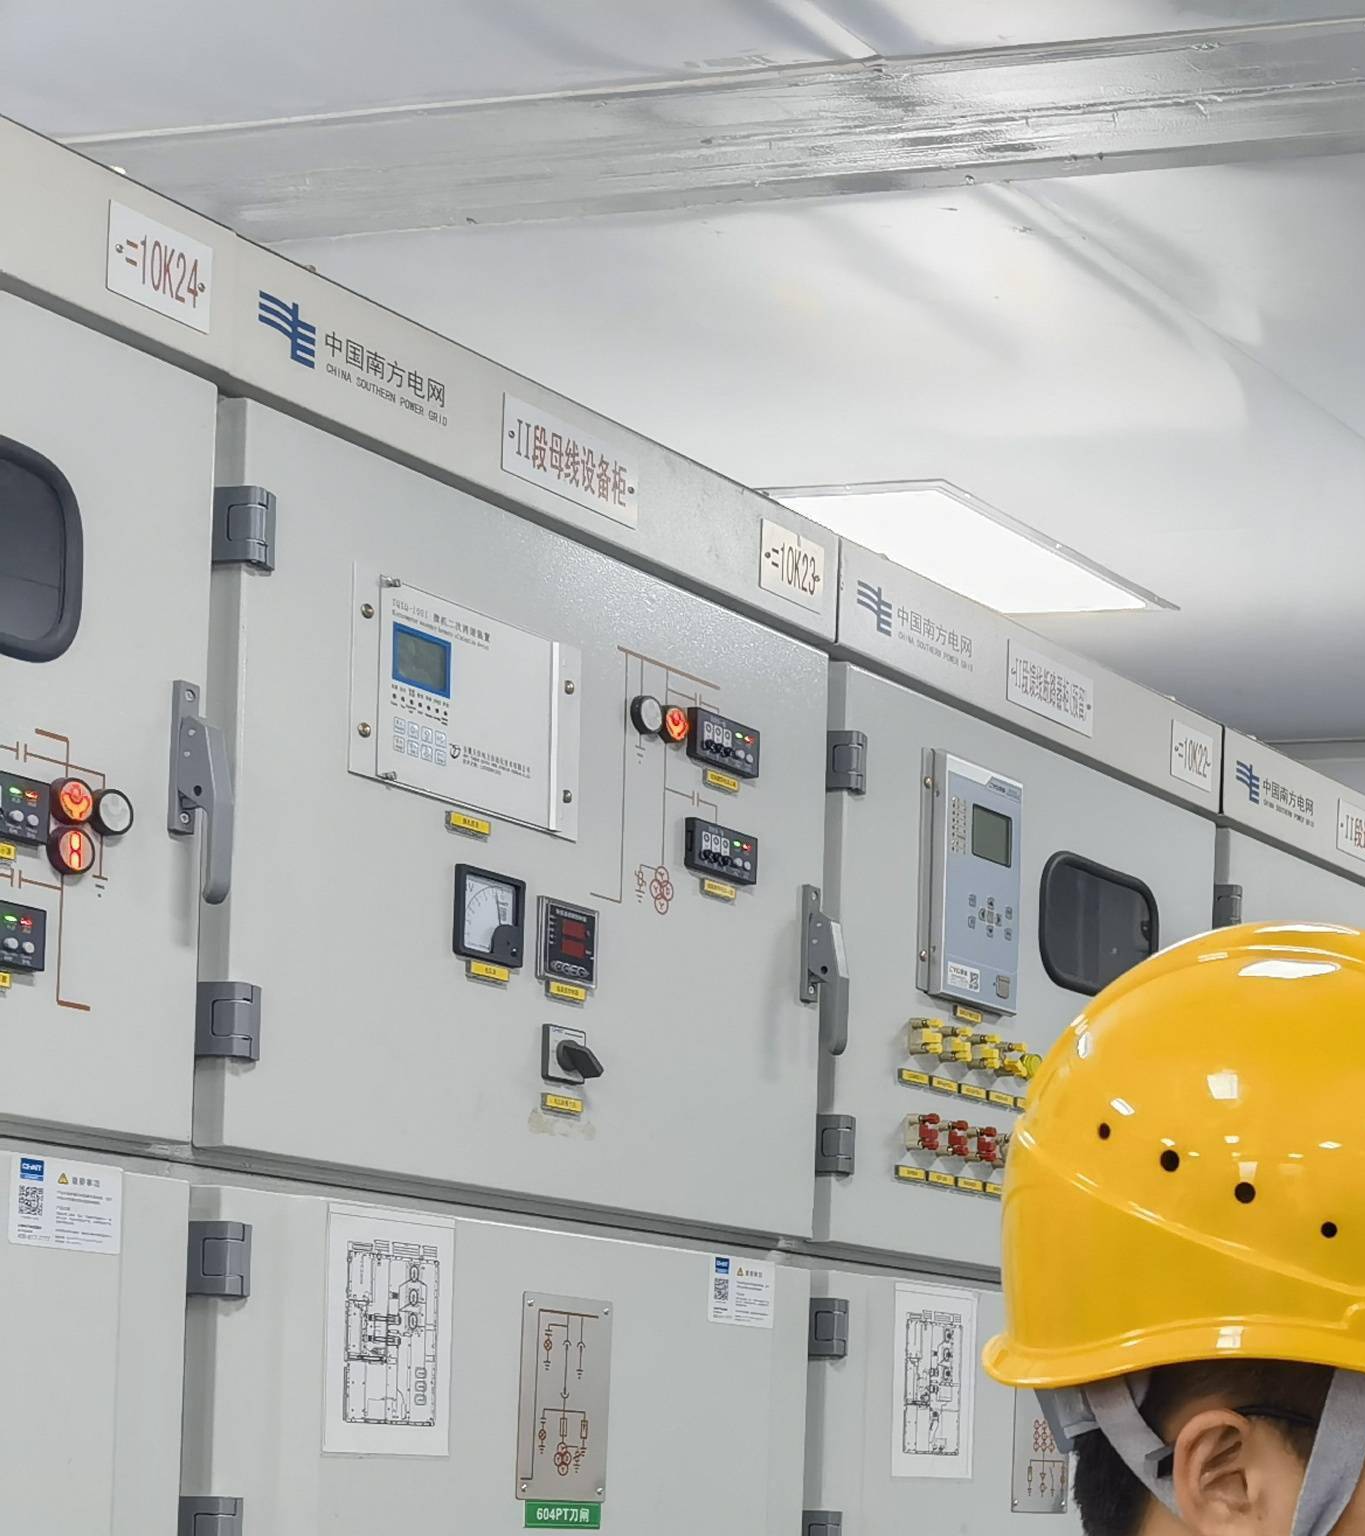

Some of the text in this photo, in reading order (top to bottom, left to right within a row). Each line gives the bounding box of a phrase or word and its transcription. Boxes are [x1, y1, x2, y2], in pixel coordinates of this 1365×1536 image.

[126, 235, 198, 308] =10K24
[325, 331, 445, 408] 中国南方电网
[326, 363, 447, 427] CHINA SOUTHERN POWER GRID
[772, 542, 817, 596] =10K23
[897, 606, 972, 658] 中国南方电网
[1263, 778, 1313, 816] 中国南方电网
